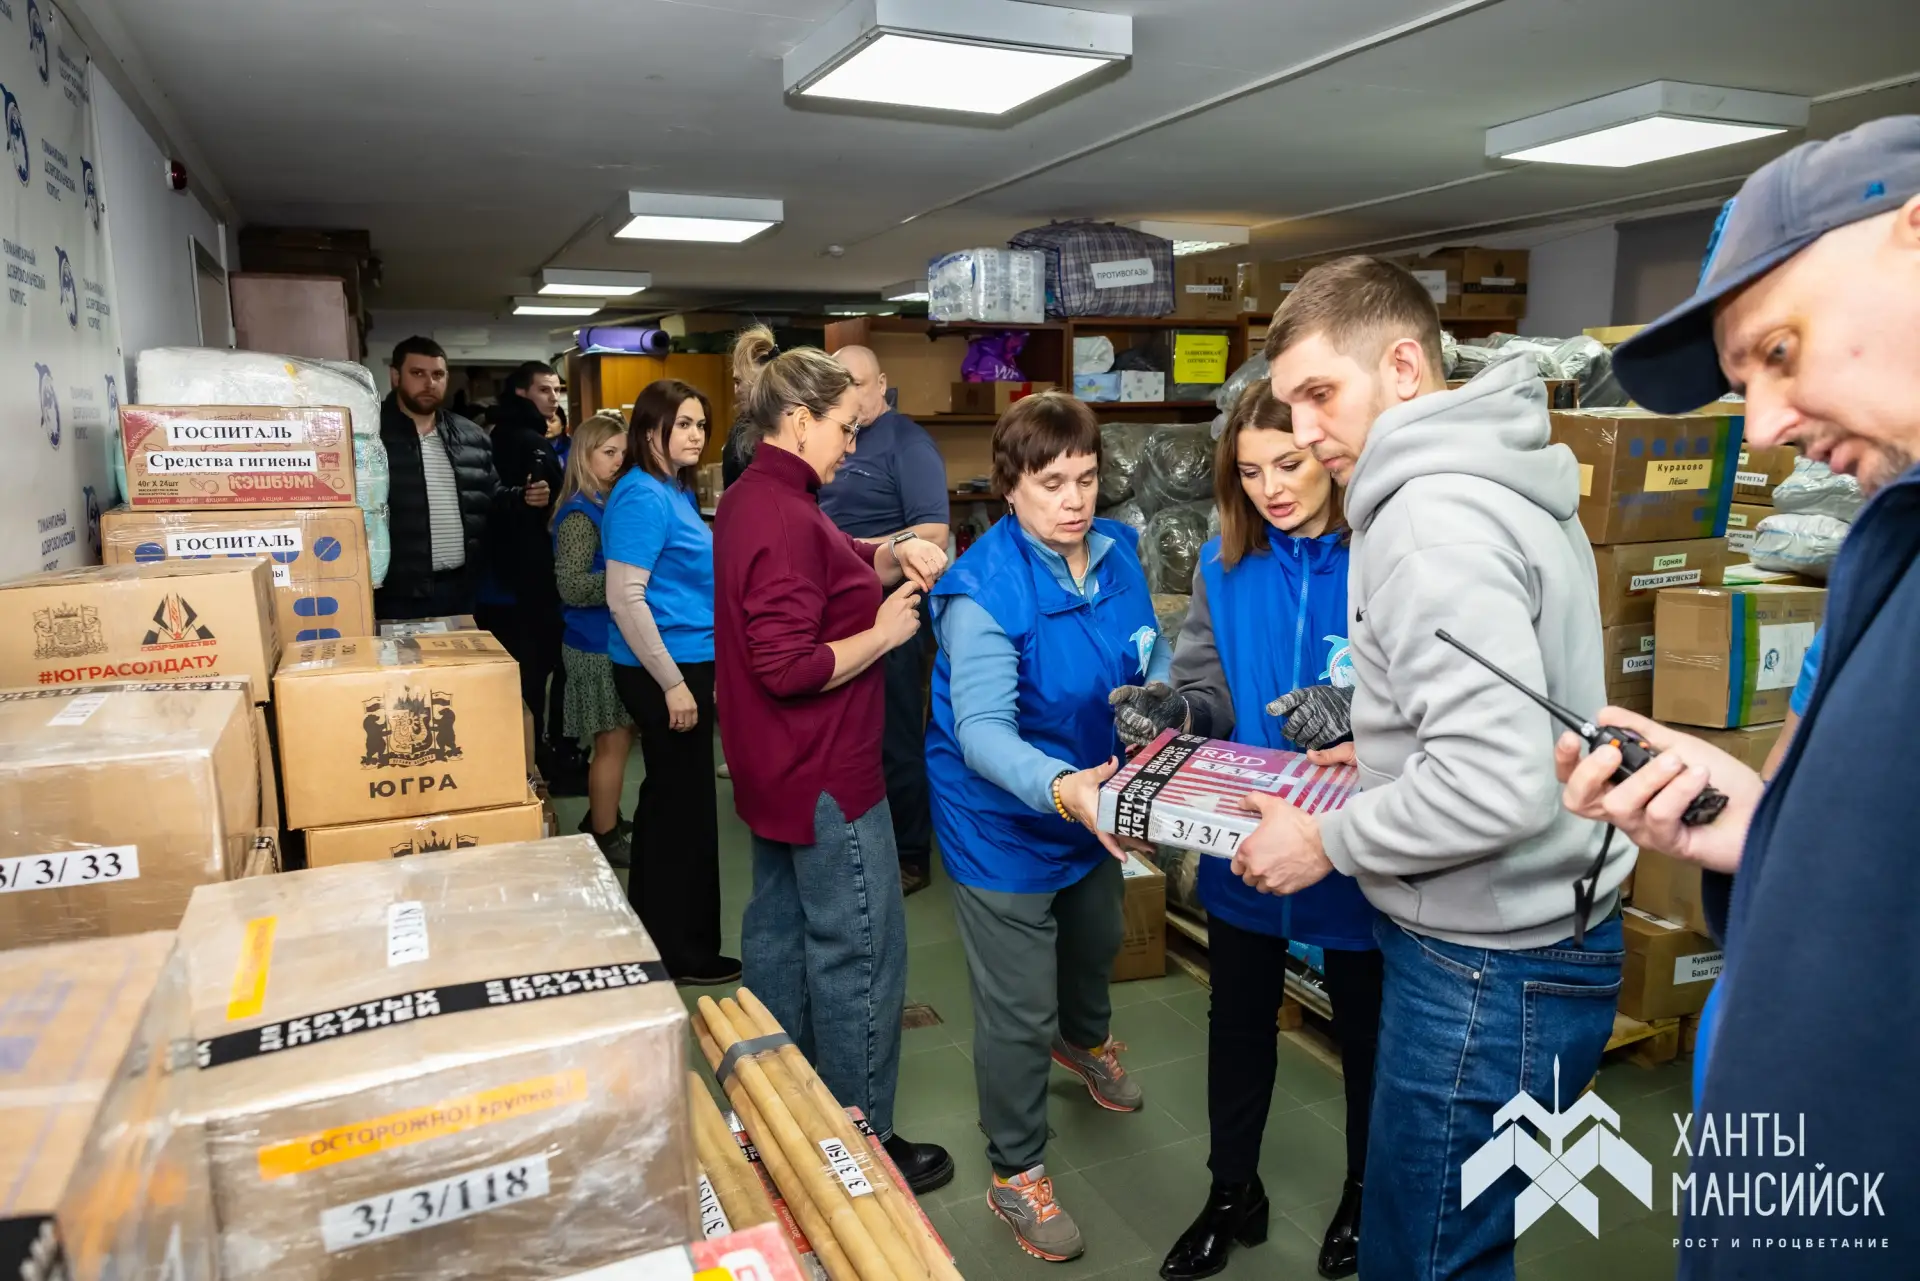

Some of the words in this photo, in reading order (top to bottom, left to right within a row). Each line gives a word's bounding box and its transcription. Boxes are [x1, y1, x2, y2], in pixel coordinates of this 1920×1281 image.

[1096, 268, 1149, 279] ПРОТИВОГАЗЫ
[173, 426, 292, 439] ГОСПИТАЛЬ
[150, 454, 233, 470] Средства
[239, 457, 311, 467] гигиены
[1657, 464, 1704, 473] Курахово
[1668, 477, 1689, 486] Лёше
[176, 534, 295, 551] ГОСПИТАЛЬ
[1658, 557, 1683, 567] Горняк
[1633, 576, 1664, 587] Одежда
[1666, 573, 1698, 584] женская
[1643, 638, 1654, 648] Гор
[38, 654, 218, 684] #ЮГРАСОЛДАТУ
[1627, 659, 1653, 669] Одежд
[369, 773, 458, 799] ЮГРА
[1132, 784, 1157, 841] КРУТЫХ
[1172, 820, 1194, 840] 3/
[1198, 825, 1221, 847] 3/
[35, 856, 68, 885] 3/
[81, 852, 122, 880] 33
[509, 964, 642, 990] КРУТЫХ
[1691, 969, 1709, 978] База
[288, 989, 439, 1034] КРУТЫХ
[309, 1104, 471, 1156] ОСТОРОЖНО!
[824, 1144, 859, 1176] 3/150
[848, 1177, 867, 1190] 3/
[352, 1197, 394, 1239] 3/
[410, 1165, 530, 1224] 3/118
[704, 1217, 724, 1235] 3/
